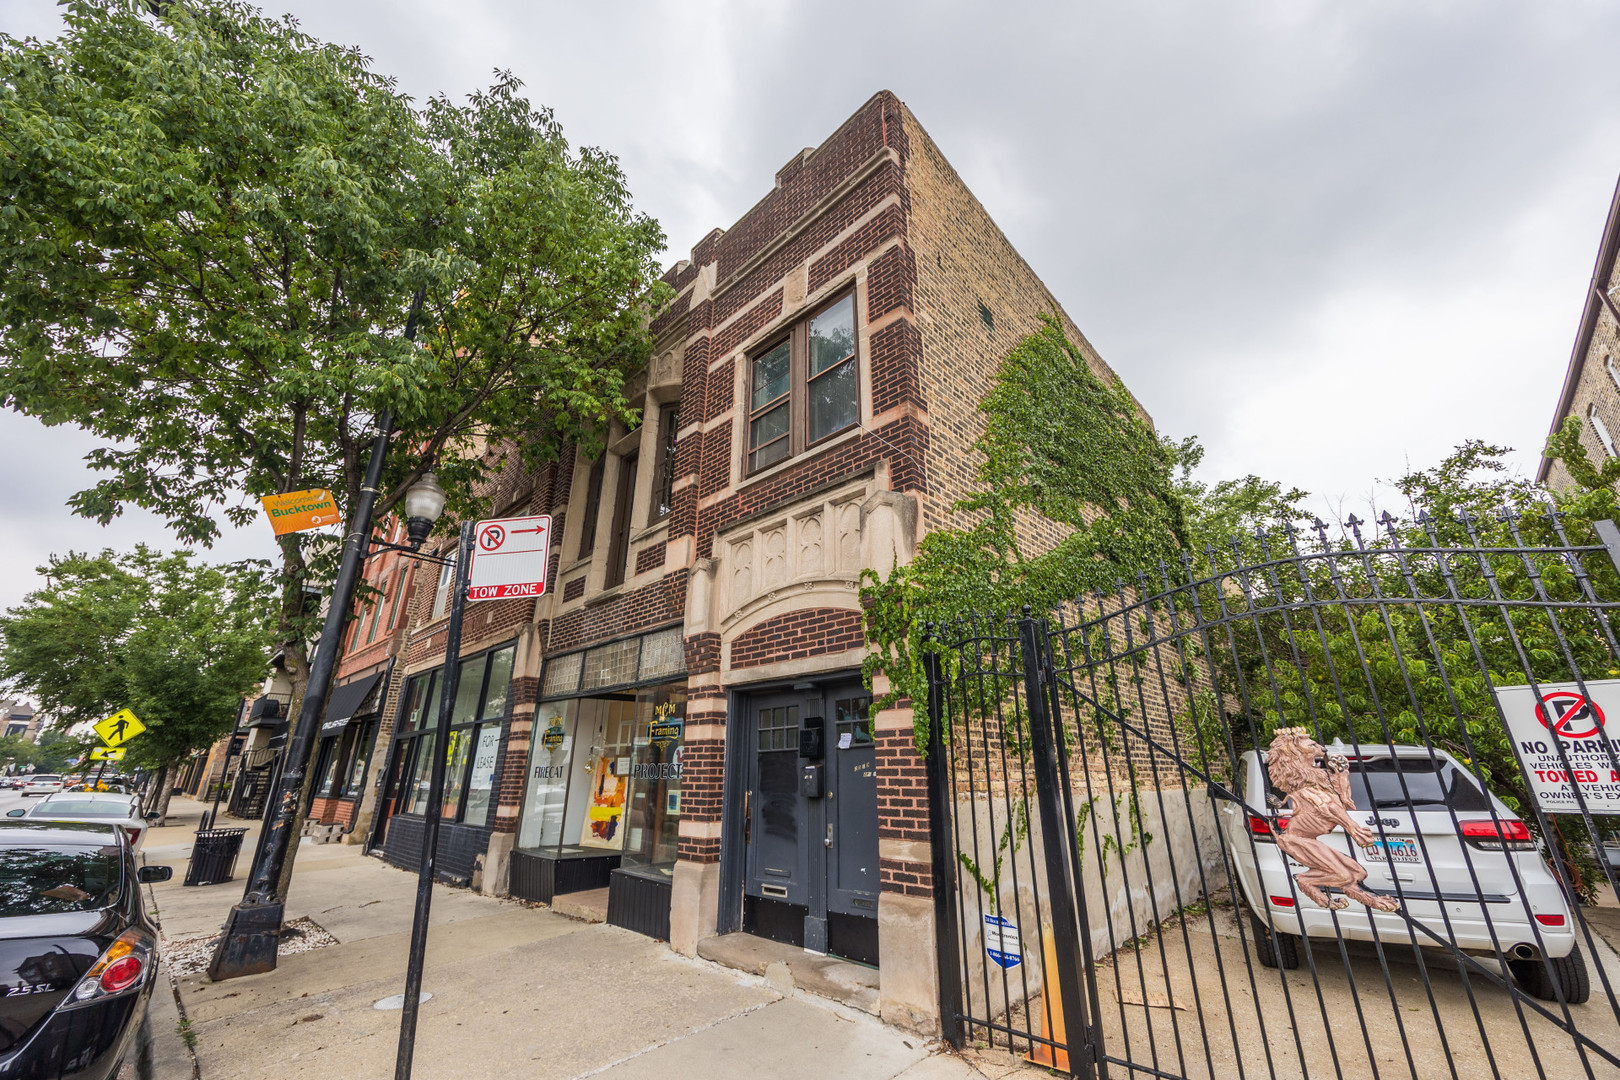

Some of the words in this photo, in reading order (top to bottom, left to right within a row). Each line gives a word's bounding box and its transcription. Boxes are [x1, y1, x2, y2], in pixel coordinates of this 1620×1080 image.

[271, 501, 331, 517] Bucktown
[473, 586, 498, 598] TOW
[503, 583, 537, 596] ZONE
[647, 720, 680, 745] Framing
[542, 729, 563, 751] Framing
[1520, 741, 1548, 754] NO
[476, 755, 495, 769] LEASE
[534, 765, 565, 779] FIRECAT
[633, 763, 684, 780] PROJECT
[1534, 770, 1599, 783] TOWED
[1365, 816, 1400, 828] Jep
